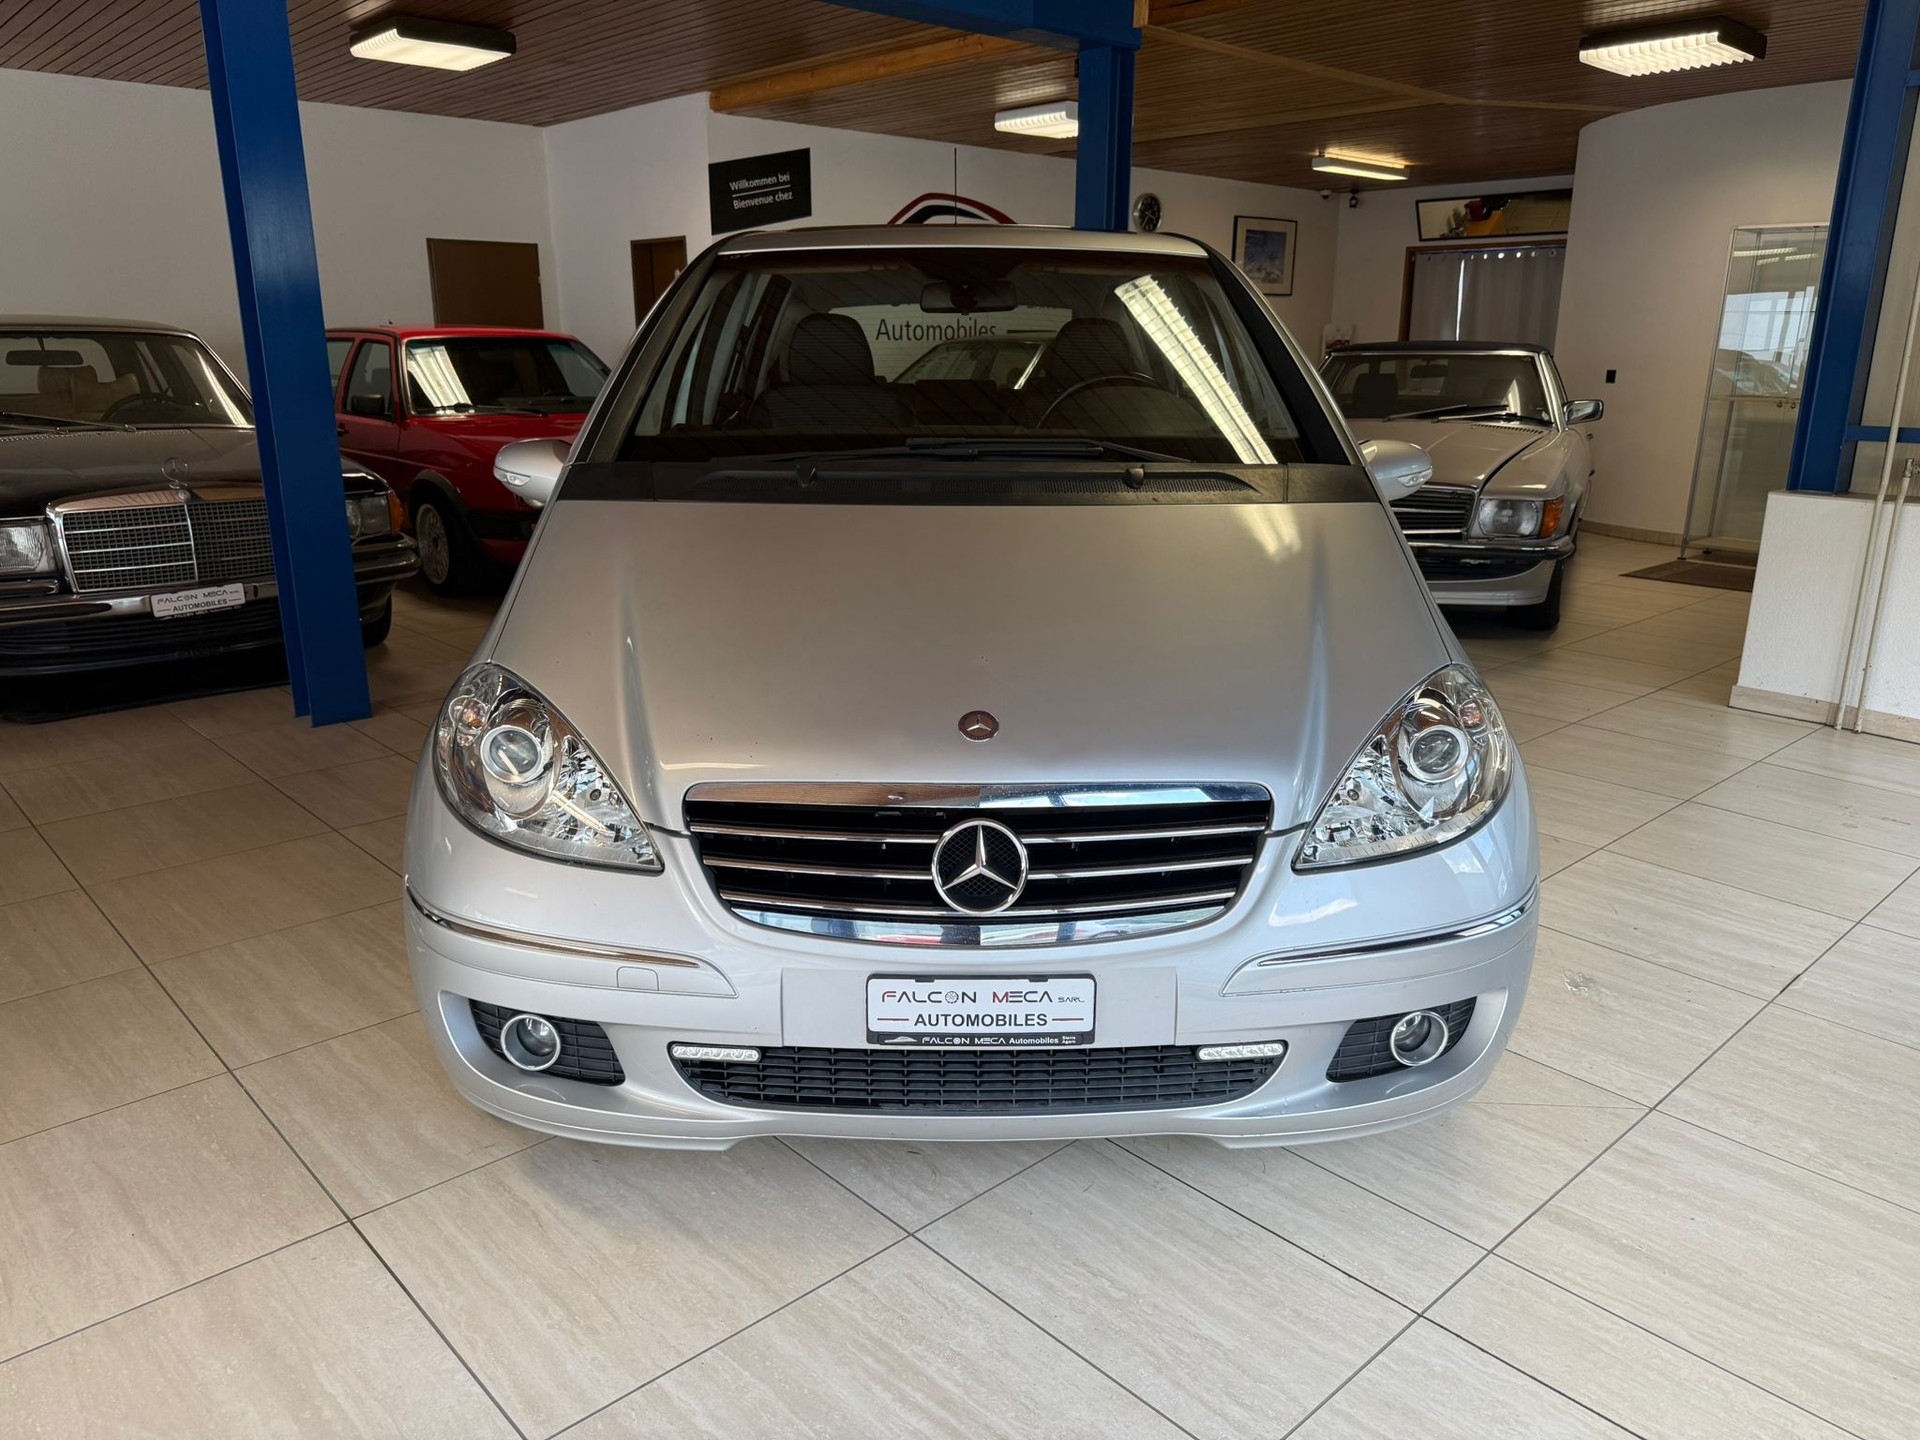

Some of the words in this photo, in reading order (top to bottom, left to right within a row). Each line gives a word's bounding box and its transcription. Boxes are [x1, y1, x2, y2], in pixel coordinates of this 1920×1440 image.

[729, 176, 777, 191] Willkommen
[778, 172, 791, 183] bei
[733, 195, 774, 210] Bienvenue
[775, 191, 794, 202] chez
[876, 317, 997, 341] Automobiles
[157, 593, 198, 605] FALCON
[173, 598, 228, 613] AUTOMOBILES
[881, 990, 977, 1004] FALCON
[992, 990, 1053, 1004] MECA
[914, 1013, 1048, 1027] AUTOMOBILES
[922, 1036, 970, 1045] FALCON
[974, 1036, 1006, 1045] MECA
[1009, 1036, 1059, 1045] Automobiles
